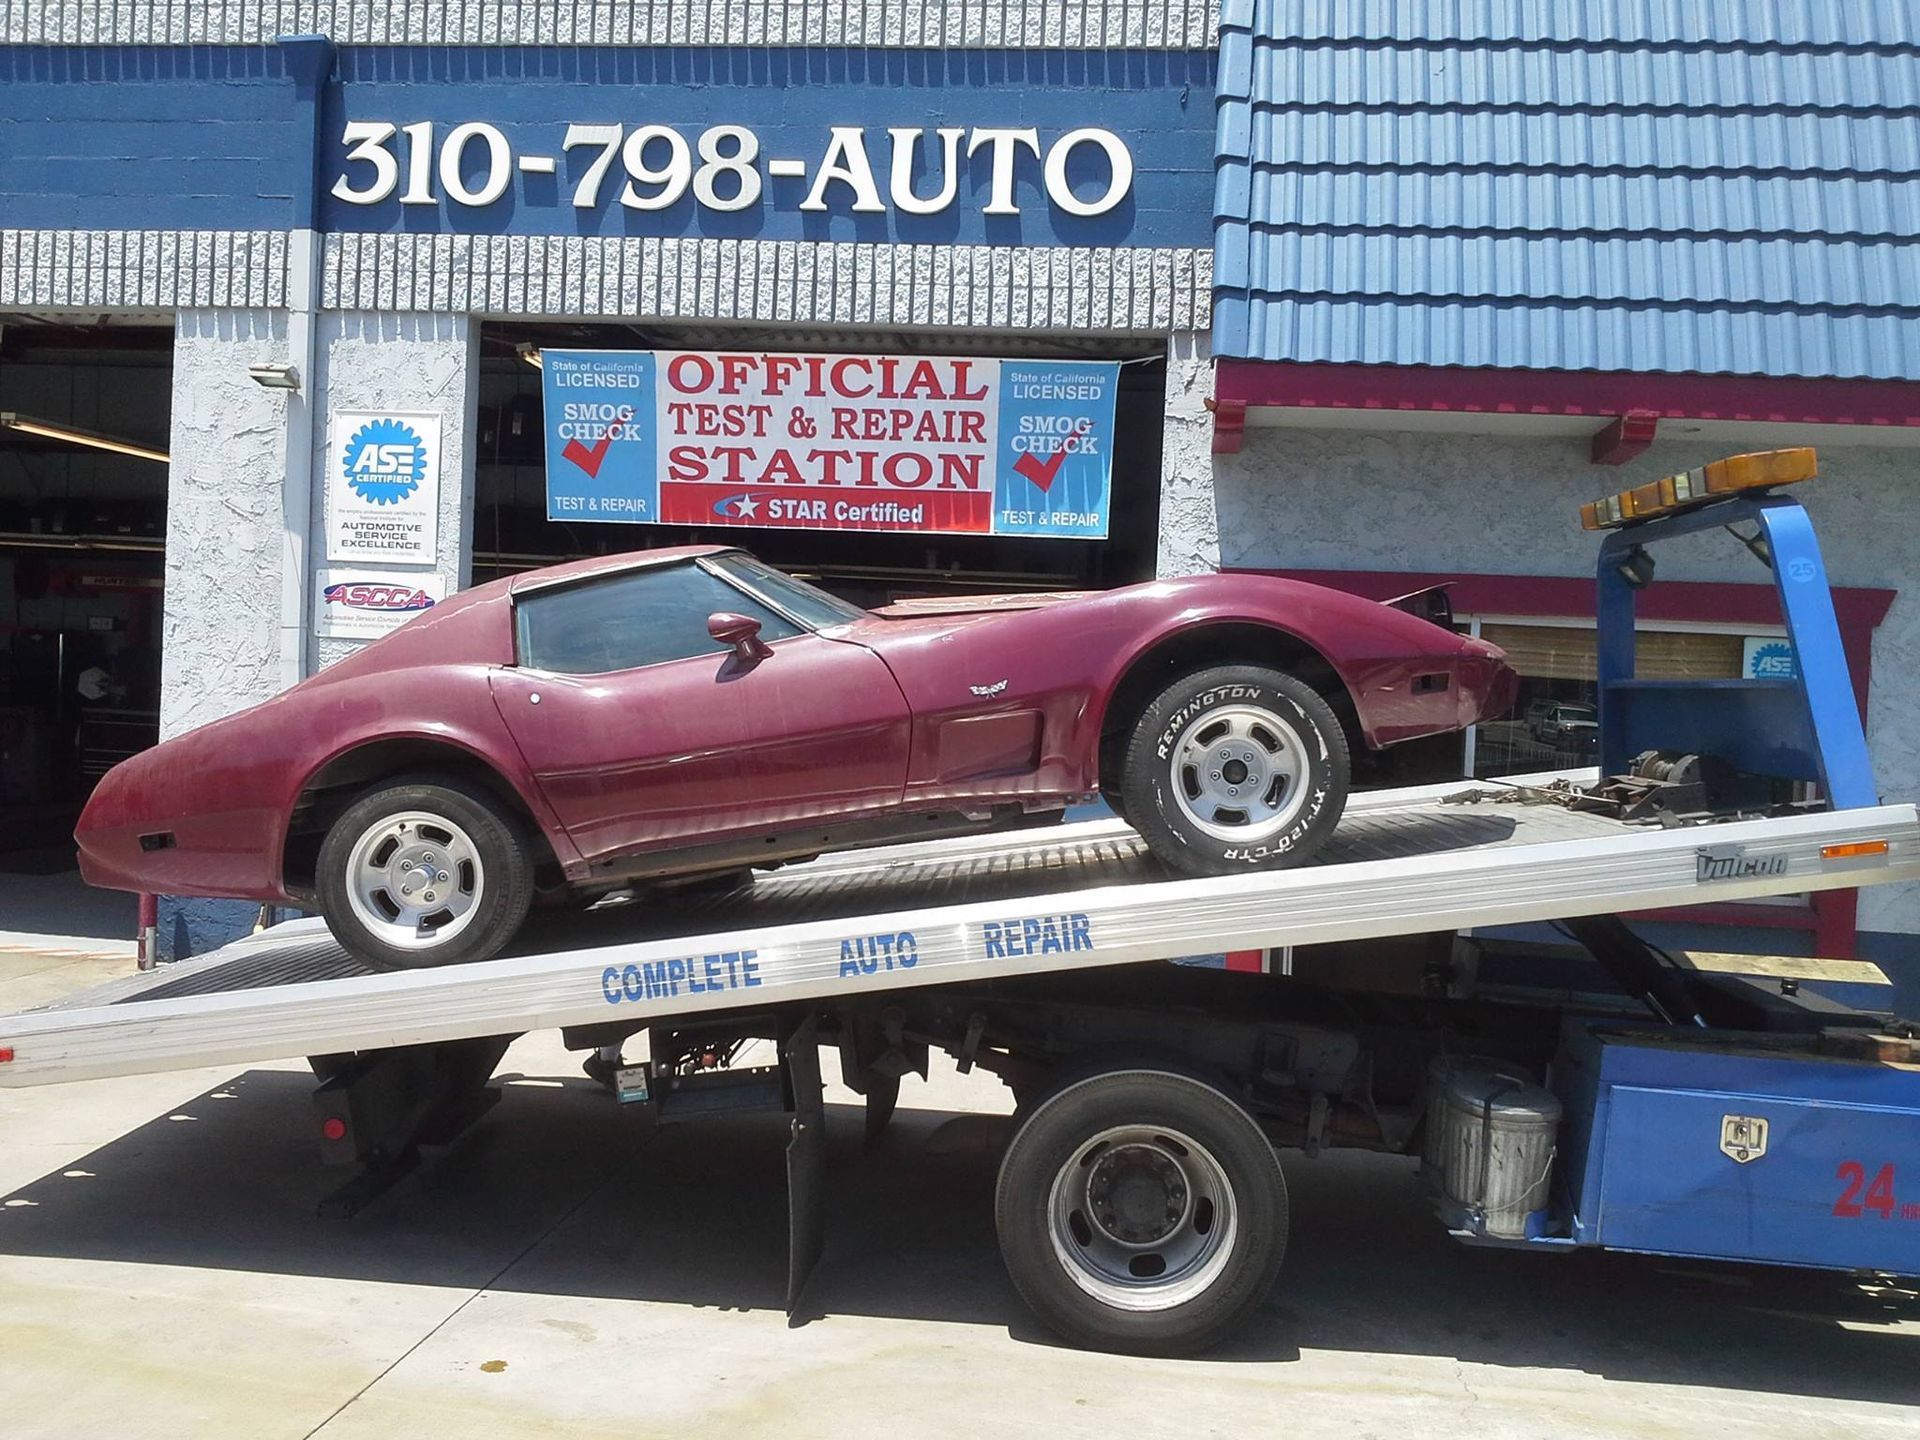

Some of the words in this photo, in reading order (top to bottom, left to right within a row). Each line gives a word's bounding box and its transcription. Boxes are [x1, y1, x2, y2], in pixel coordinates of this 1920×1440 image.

[330, 120, 1134, 216] 310-798-AUTO
[551, 361, 578, 371] State
[580, 362, 590, 371] of
[593, 361, 643, 373] California
[556, 373, 640, 388] LICENSED
[667, 354, 989, 401] OFFICIAL
[1011, 373, 1038, 383] State
[1041, 373, 1051, 383] of
[1054, 373, 1105, 384] California
[1013, 385, 1101, 400] LICENSED
[564, 403, 634, 422] SMOG
[667, 402, 773, 437] TEST
[787, 406, 817, 438] &
[831, 407, 987, 443] REPAIR
[1019, 416, 1092, 435] SMOG
[558, 423, 641, 441] CHECK
[1011, 435, 1098, 455] CHECK
[352, 444, 414, 474] ASE
[668, 446, 985, 489] STATION
[356, 474, 412, 483] CERTIFIED
[555, 497, 586, 511] TEST
[588, 498, 598, 511] &
[601, 498, 646, 512] REPAIR
[768, 499, 827, 520] STAR
[834, 500, 923, 523] Certified
[341, 522, 422, 532] AUTOMOTIVE
[1002, 510, 1035, 524] TEST
[1038, 511, 1048, 525] &
[1051, 512, 1099, 527] REPAIR
[341, 540, 421, 549] EXCELLENCE
[355, 531, 408, 540] SERVICE
[1790, 562, 1814, 577] 25
[324, 585, 426, 608] ASCCA
[1757, 656, 1791, 672] ASE
[1157, 687, 1262, 760] REMINGTON
[602, 950, 762, 1004] COMPLETE
[840, 932, 919, 977] AUTO
[983, 913, 1094, 958] REPAIR
[1831, 1160, 1896, 1220] 24
